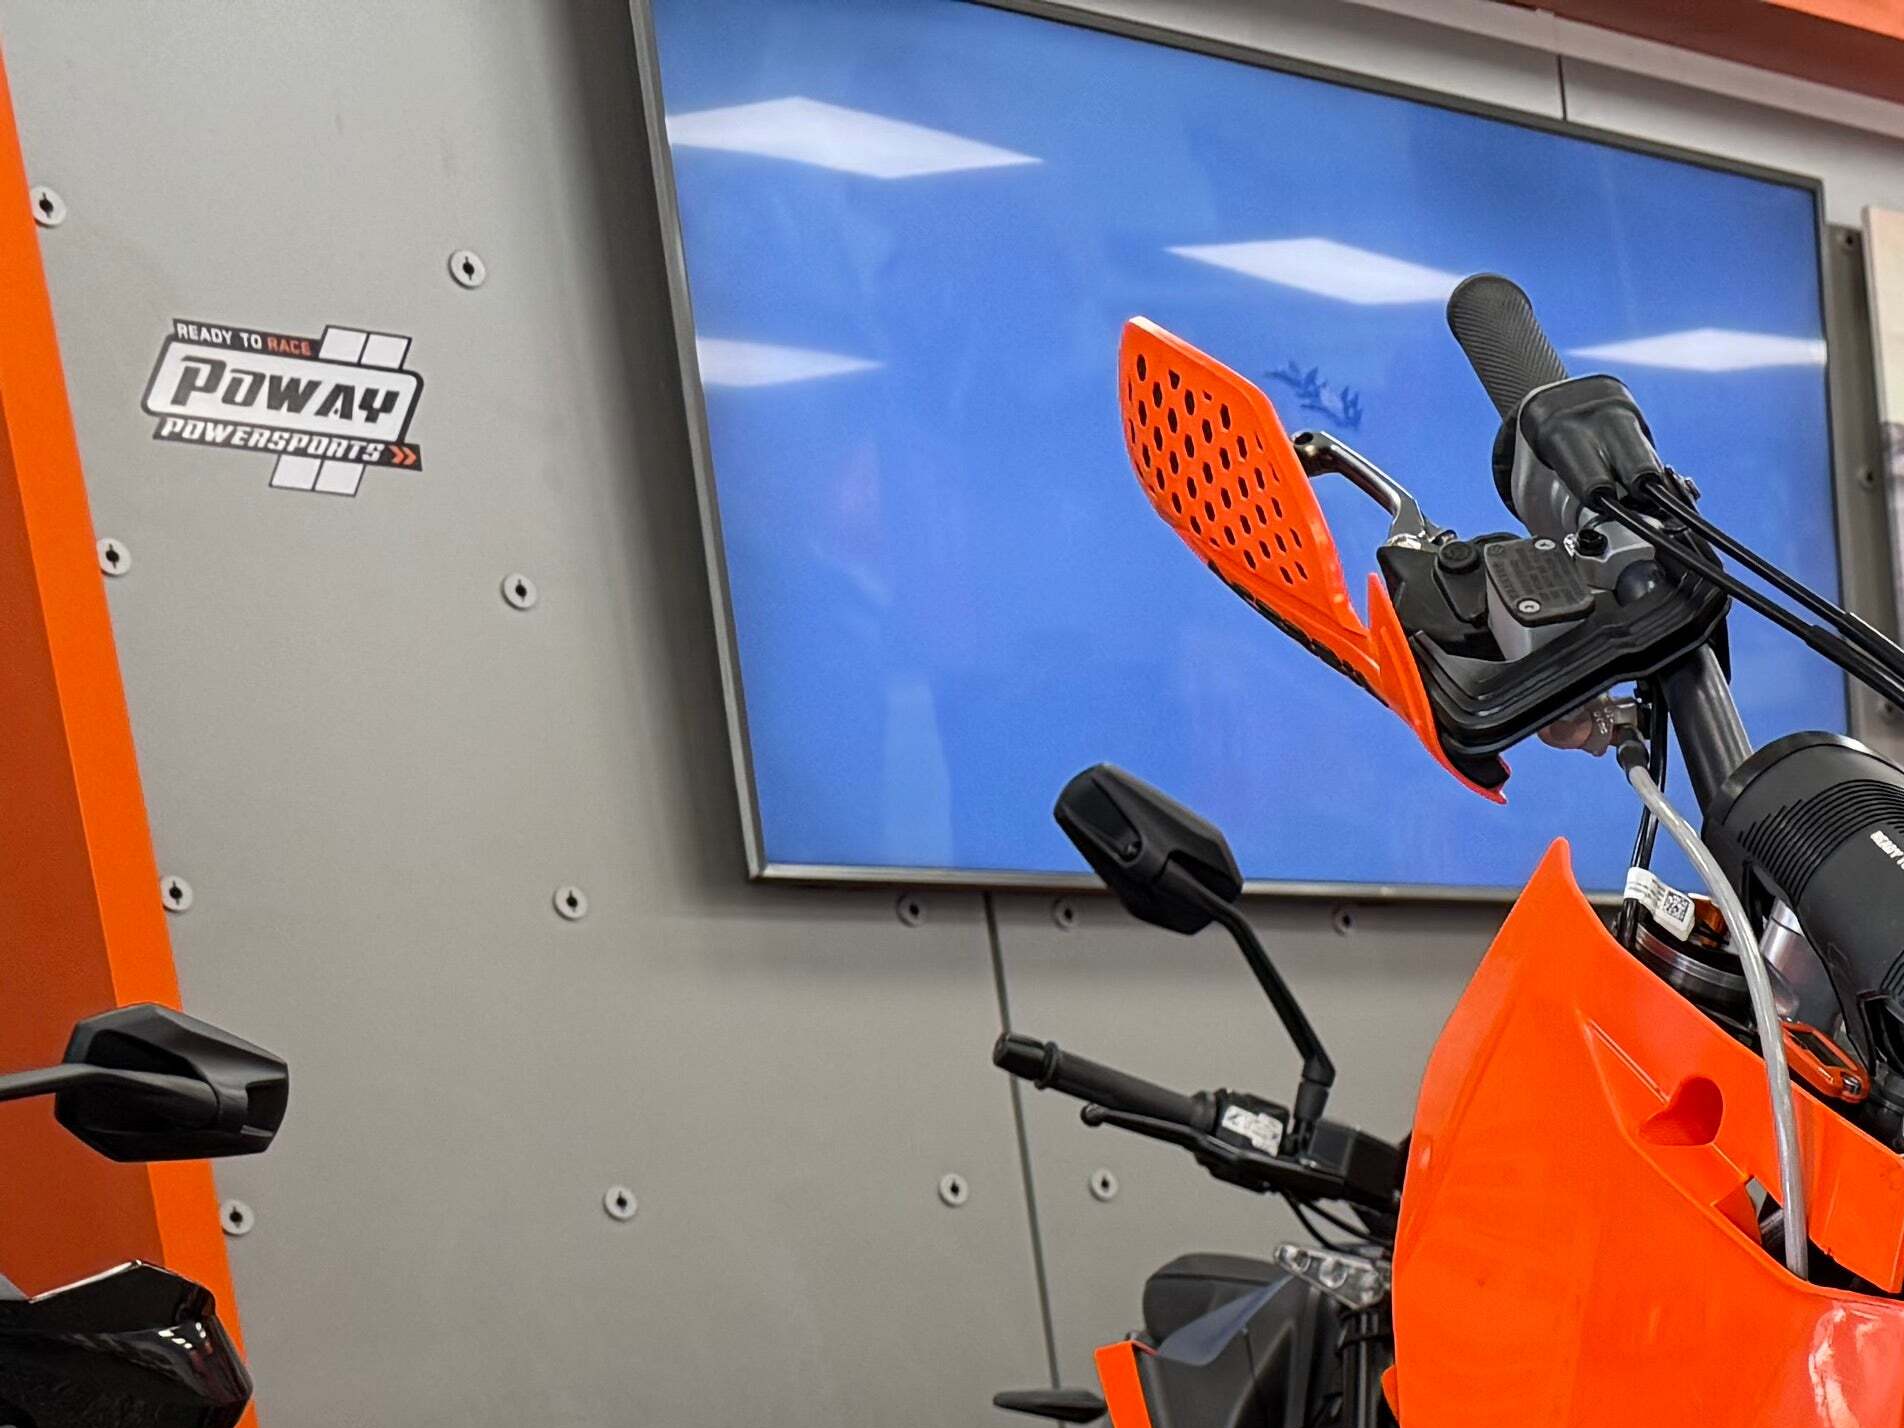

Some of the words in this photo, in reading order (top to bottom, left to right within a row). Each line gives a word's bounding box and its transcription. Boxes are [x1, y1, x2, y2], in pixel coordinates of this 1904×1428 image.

[177, 323, 233, 344] READY
[240, 333, 262, 349] TO
[267, 336, 312, 356] RACE
[170, 355, 400, 423] POWAY
[161, 417, 385, 462] POWERSPORTS
[1870, 830, 1904, 858] READY
